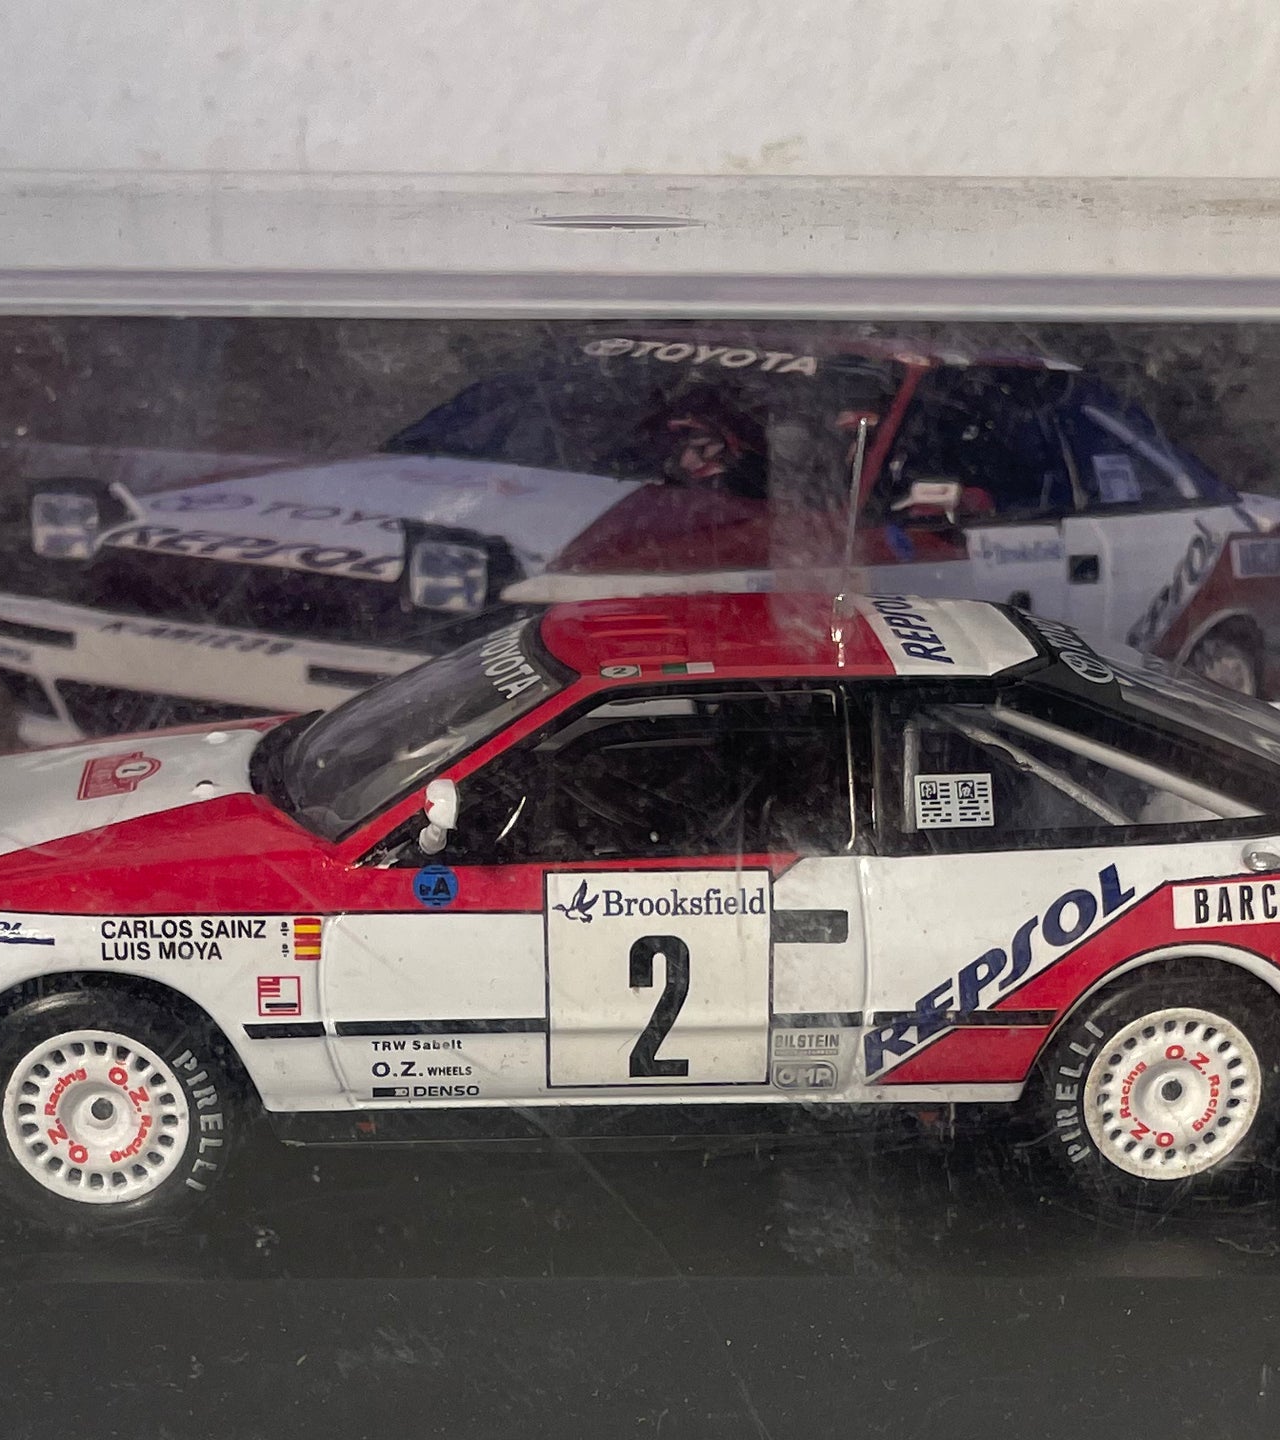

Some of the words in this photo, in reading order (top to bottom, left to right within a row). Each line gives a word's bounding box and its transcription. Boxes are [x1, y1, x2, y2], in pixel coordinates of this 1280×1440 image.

[630, 340, 818, 376] TOYOTA
[865, 594, 955, 665] REPSOL
[479, 624, 542, 700] TOYOTA
[601, 888, 766, 916] Brooksfield
[101, 919, 193, 939] CARLOS
[200, 919, 267, 939] SAINZ
[101, 941, 151, 961] LUIS
[159, 941, 223, 961] MOYA
[864, 862, 1136, 1078] REPSOL
[629, 935, 690, 1078] 2
[371, 1041, 406, 1051] TRW
[412, 1040, 463, 1051] Sabelt
[774, 1034, 840, 1048] BILSTEIN
[371, 1061, 424, 1078] O.Z.
[427, 1066, 473, 1077] WHEELS
[413, 1085, 480, 1097] DENSO
[1055, 1020, 1105, 1163] PIRELLI
[172, 1049, 224, 1192] PIRELLI
